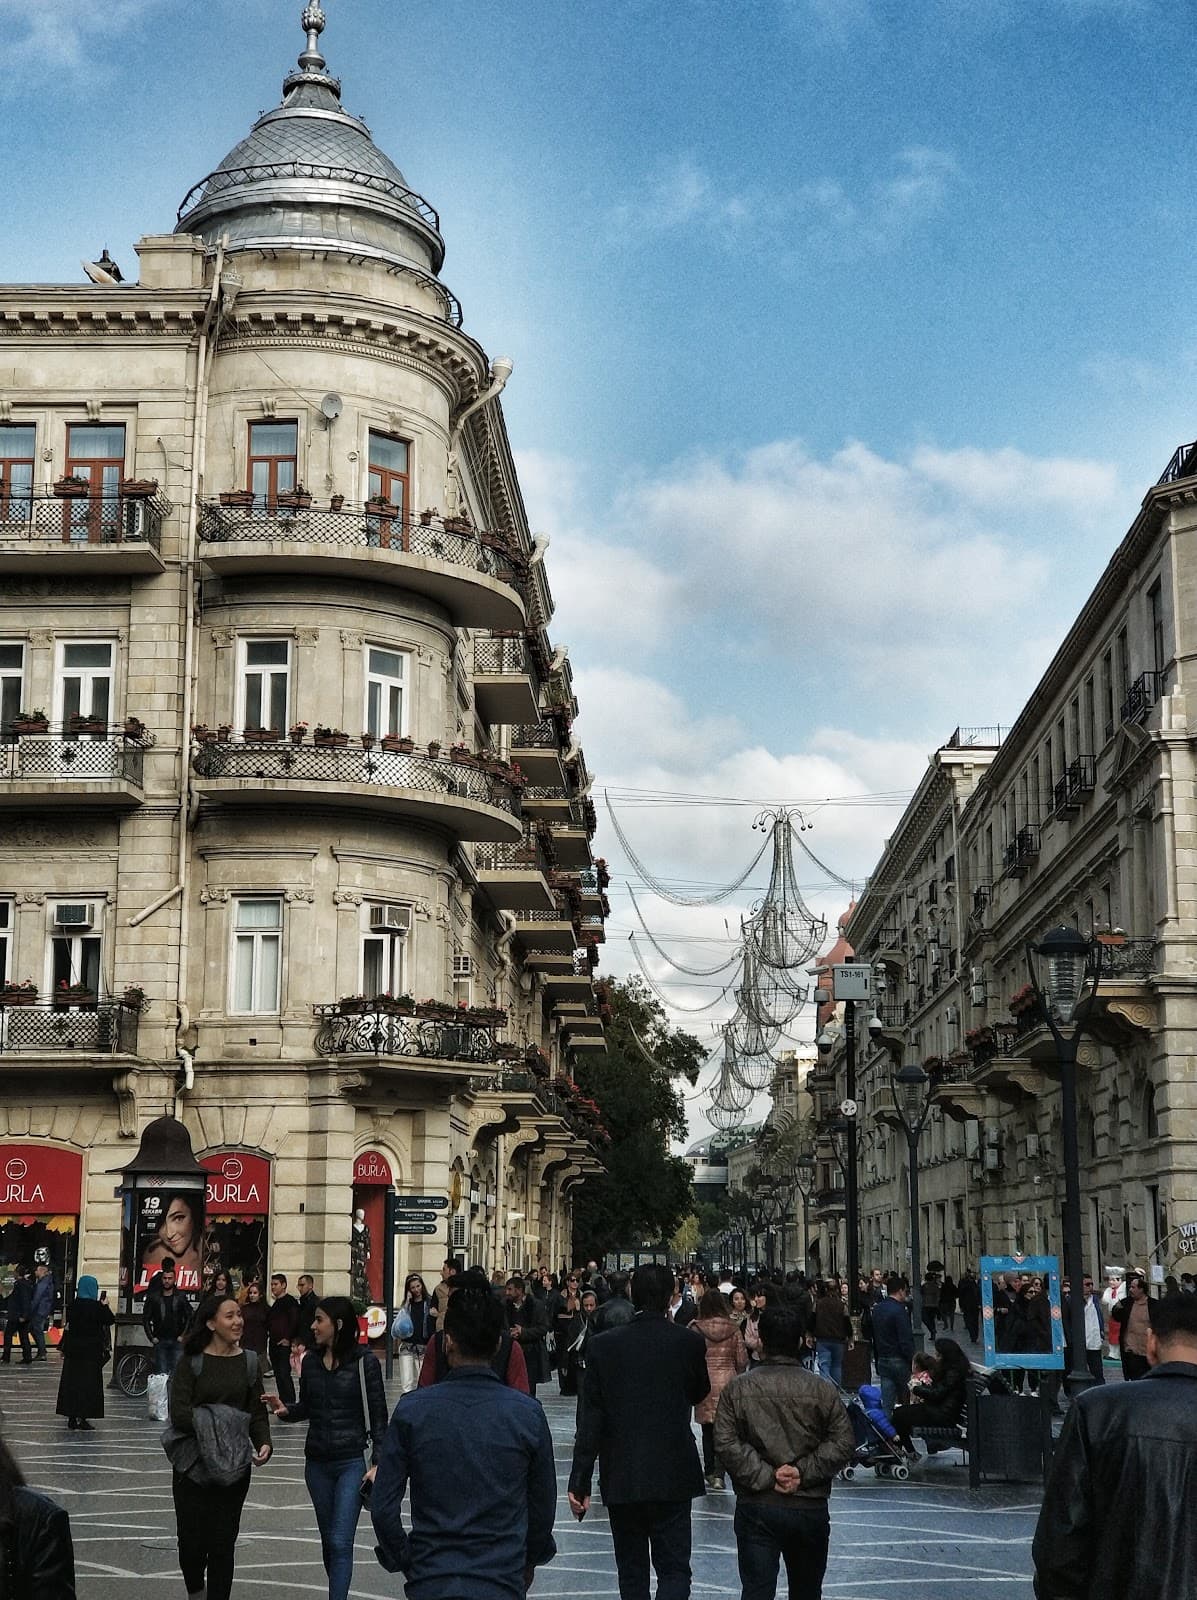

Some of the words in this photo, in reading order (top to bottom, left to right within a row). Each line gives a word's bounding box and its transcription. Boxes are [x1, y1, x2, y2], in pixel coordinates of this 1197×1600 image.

[358, 1164, 387, 1177] BURLA
[206, 1184, 260, 1203] BURLA
[143, 1196, 161, 1209] 19
[139, 1265, 199, 1287] LİTA
